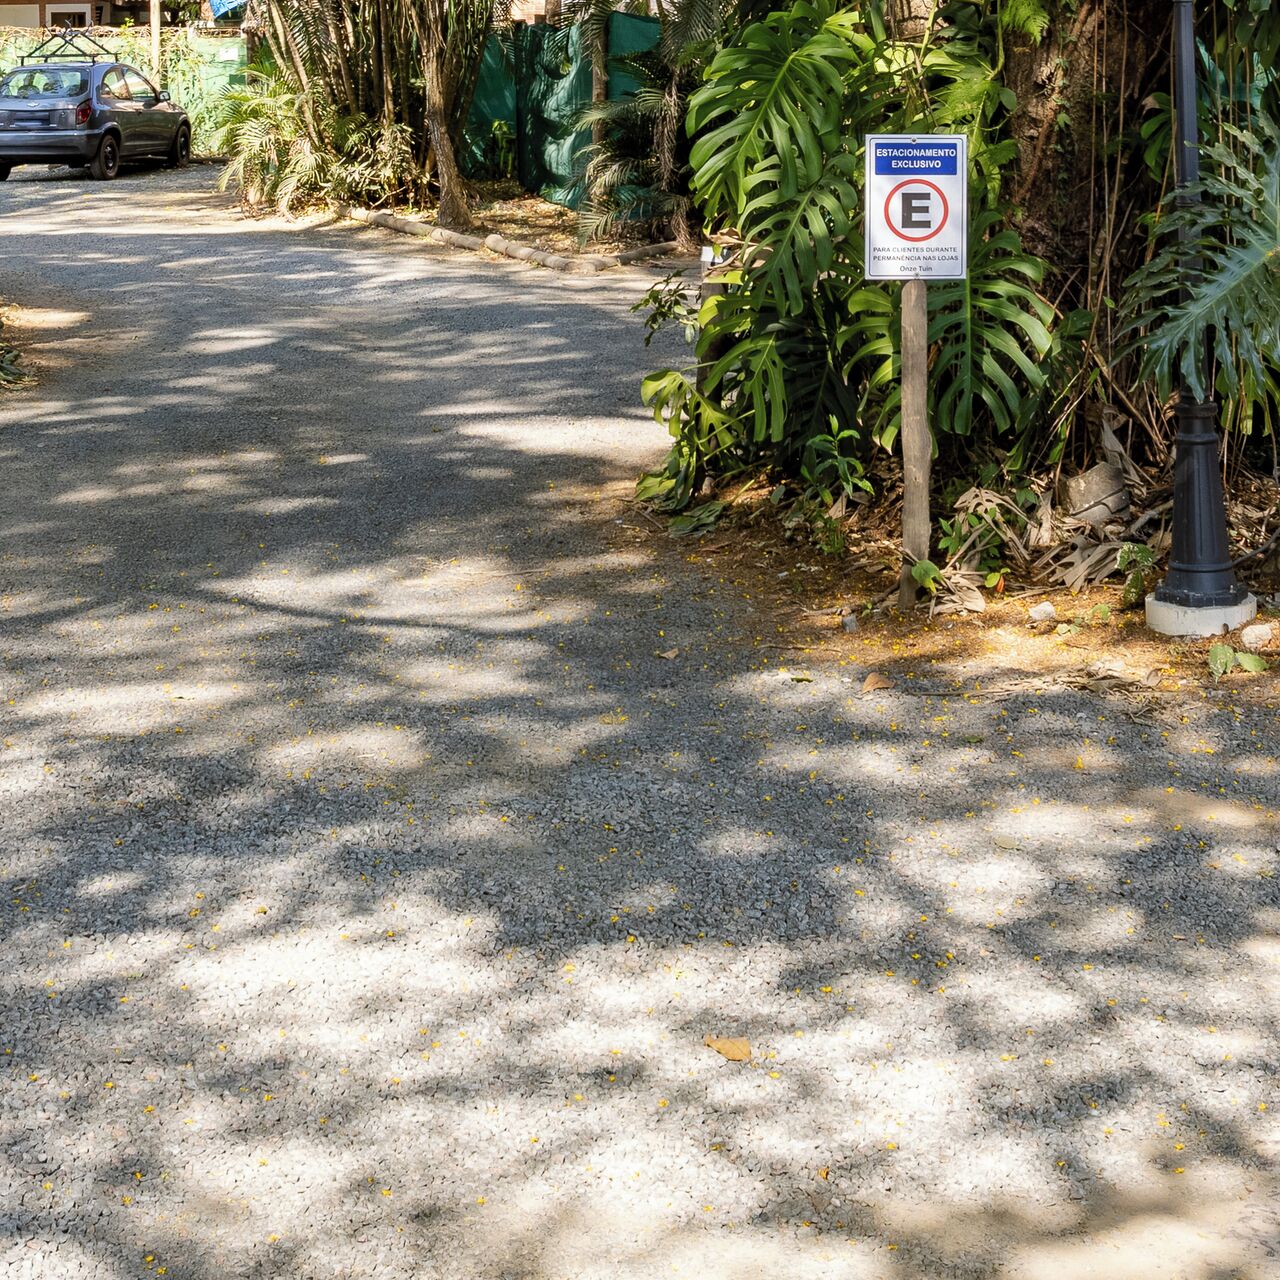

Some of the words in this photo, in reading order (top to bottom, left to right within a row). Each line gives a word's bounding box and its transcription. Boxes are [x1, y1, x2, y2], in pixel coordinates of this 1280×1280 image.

[876, 148, 957, 157] ESTACIONAMENTO
[891, 160, 942, 168] EXCLUSIVO
[901, 192, 932, 229] E
